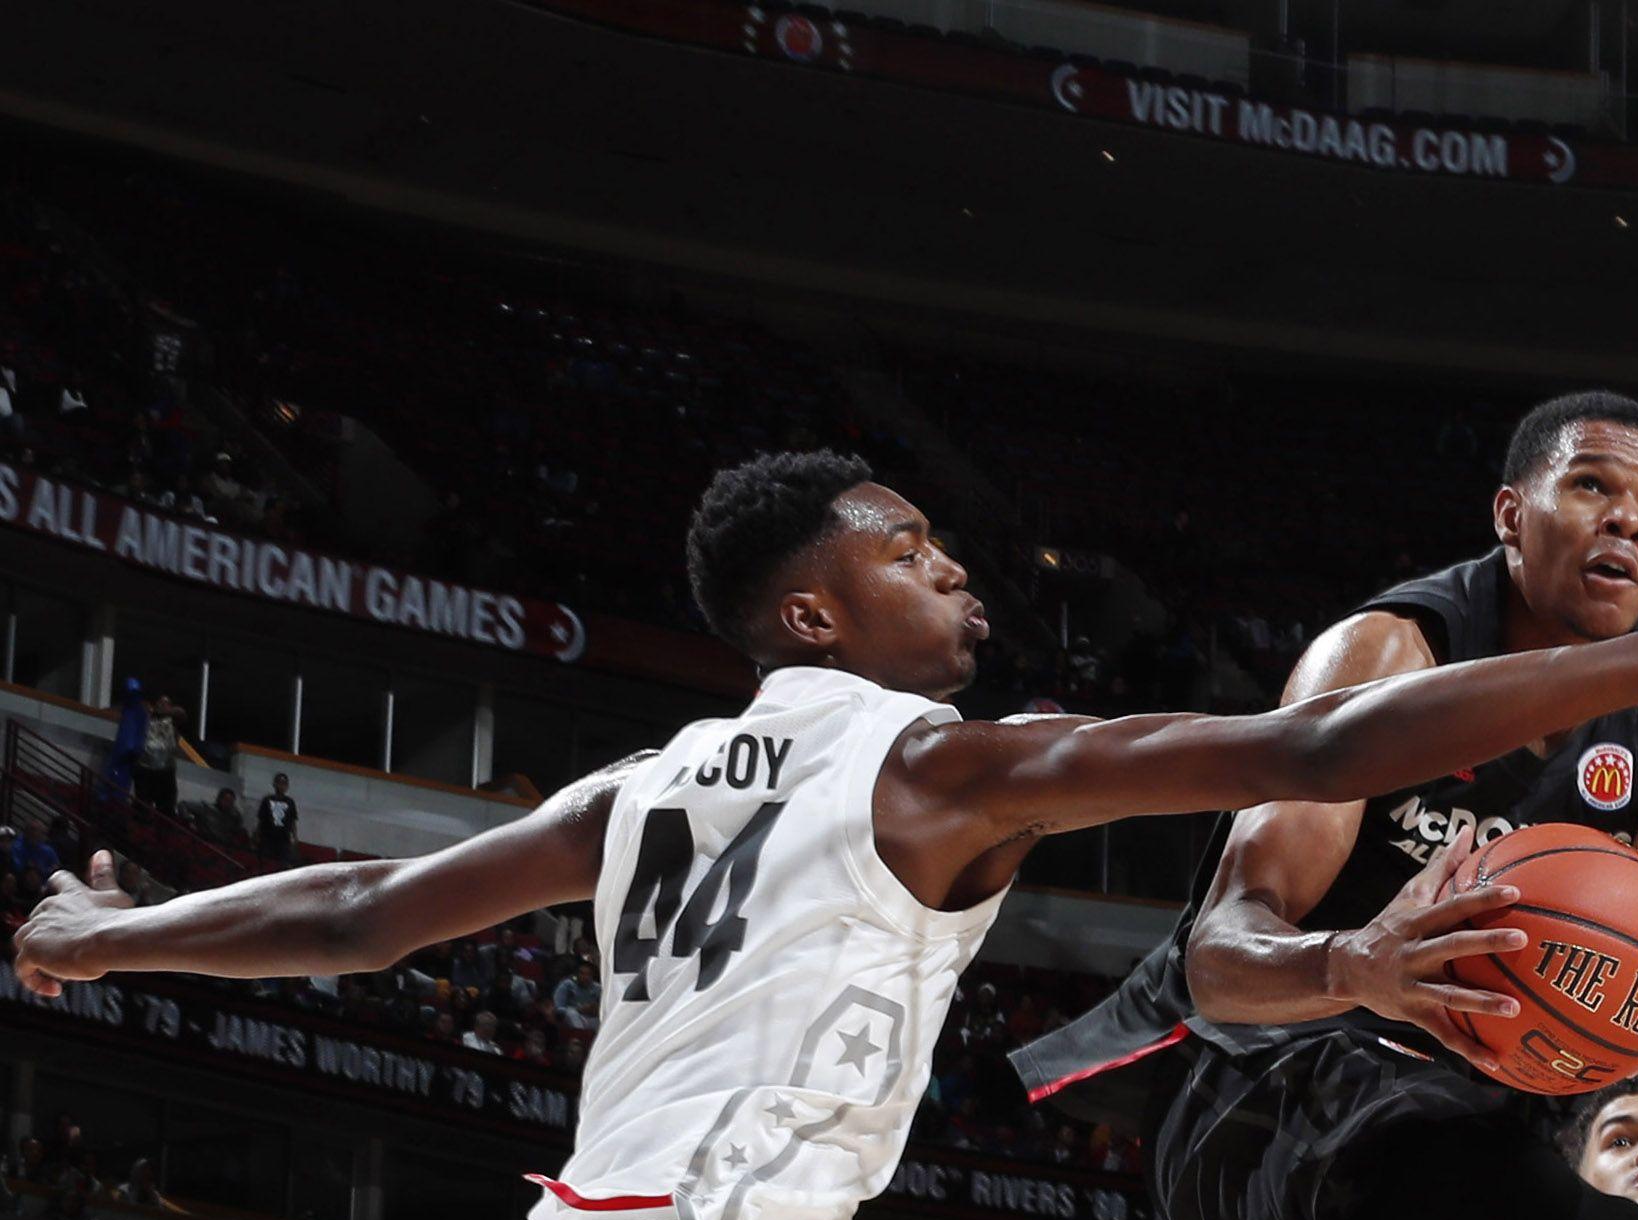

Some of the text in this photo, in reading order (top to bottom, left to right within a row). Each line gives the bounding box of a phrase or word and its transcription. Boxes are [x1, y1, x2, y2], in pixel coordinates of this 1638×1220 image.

[1126, 77, 1511, 178] VISIT McDAAG.COM
[27, 477, 107, 551] ALL
[114, 505, 353, 614] AMERICAN
[364, 564, 527, 650] GAMES
[614, 800, 788, 1001] 44
[1533, 939, 1621, 1013] THE
[208, 1009, 306, 1070] JAMES
[315, 1034, 436, 1098] WORTHY
[971, 1169, 1077, 1220] RIVERS
